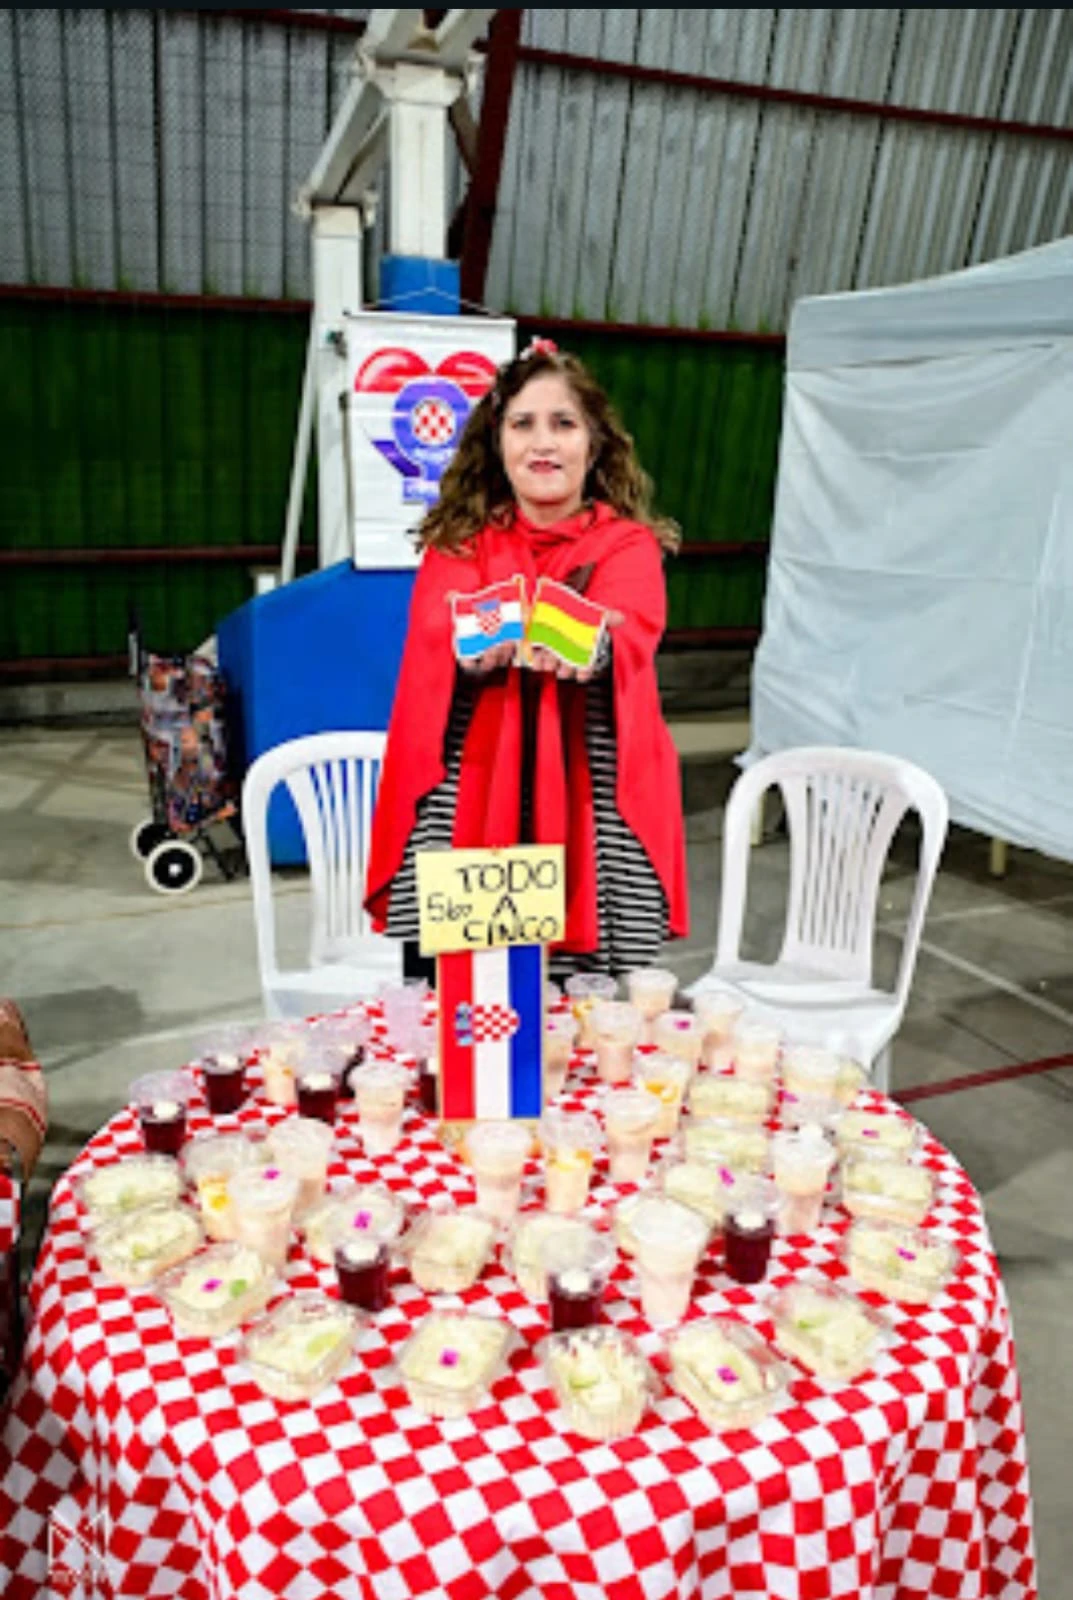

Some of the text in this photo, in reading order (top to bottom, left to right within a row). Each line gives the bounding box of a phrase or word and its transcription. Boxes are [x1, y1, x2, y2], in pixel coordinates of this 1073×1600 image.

[455, 859, 557, 893] TODO
[491, 894, 519, 920] A
[463, 915, 558, 946] CINCO
